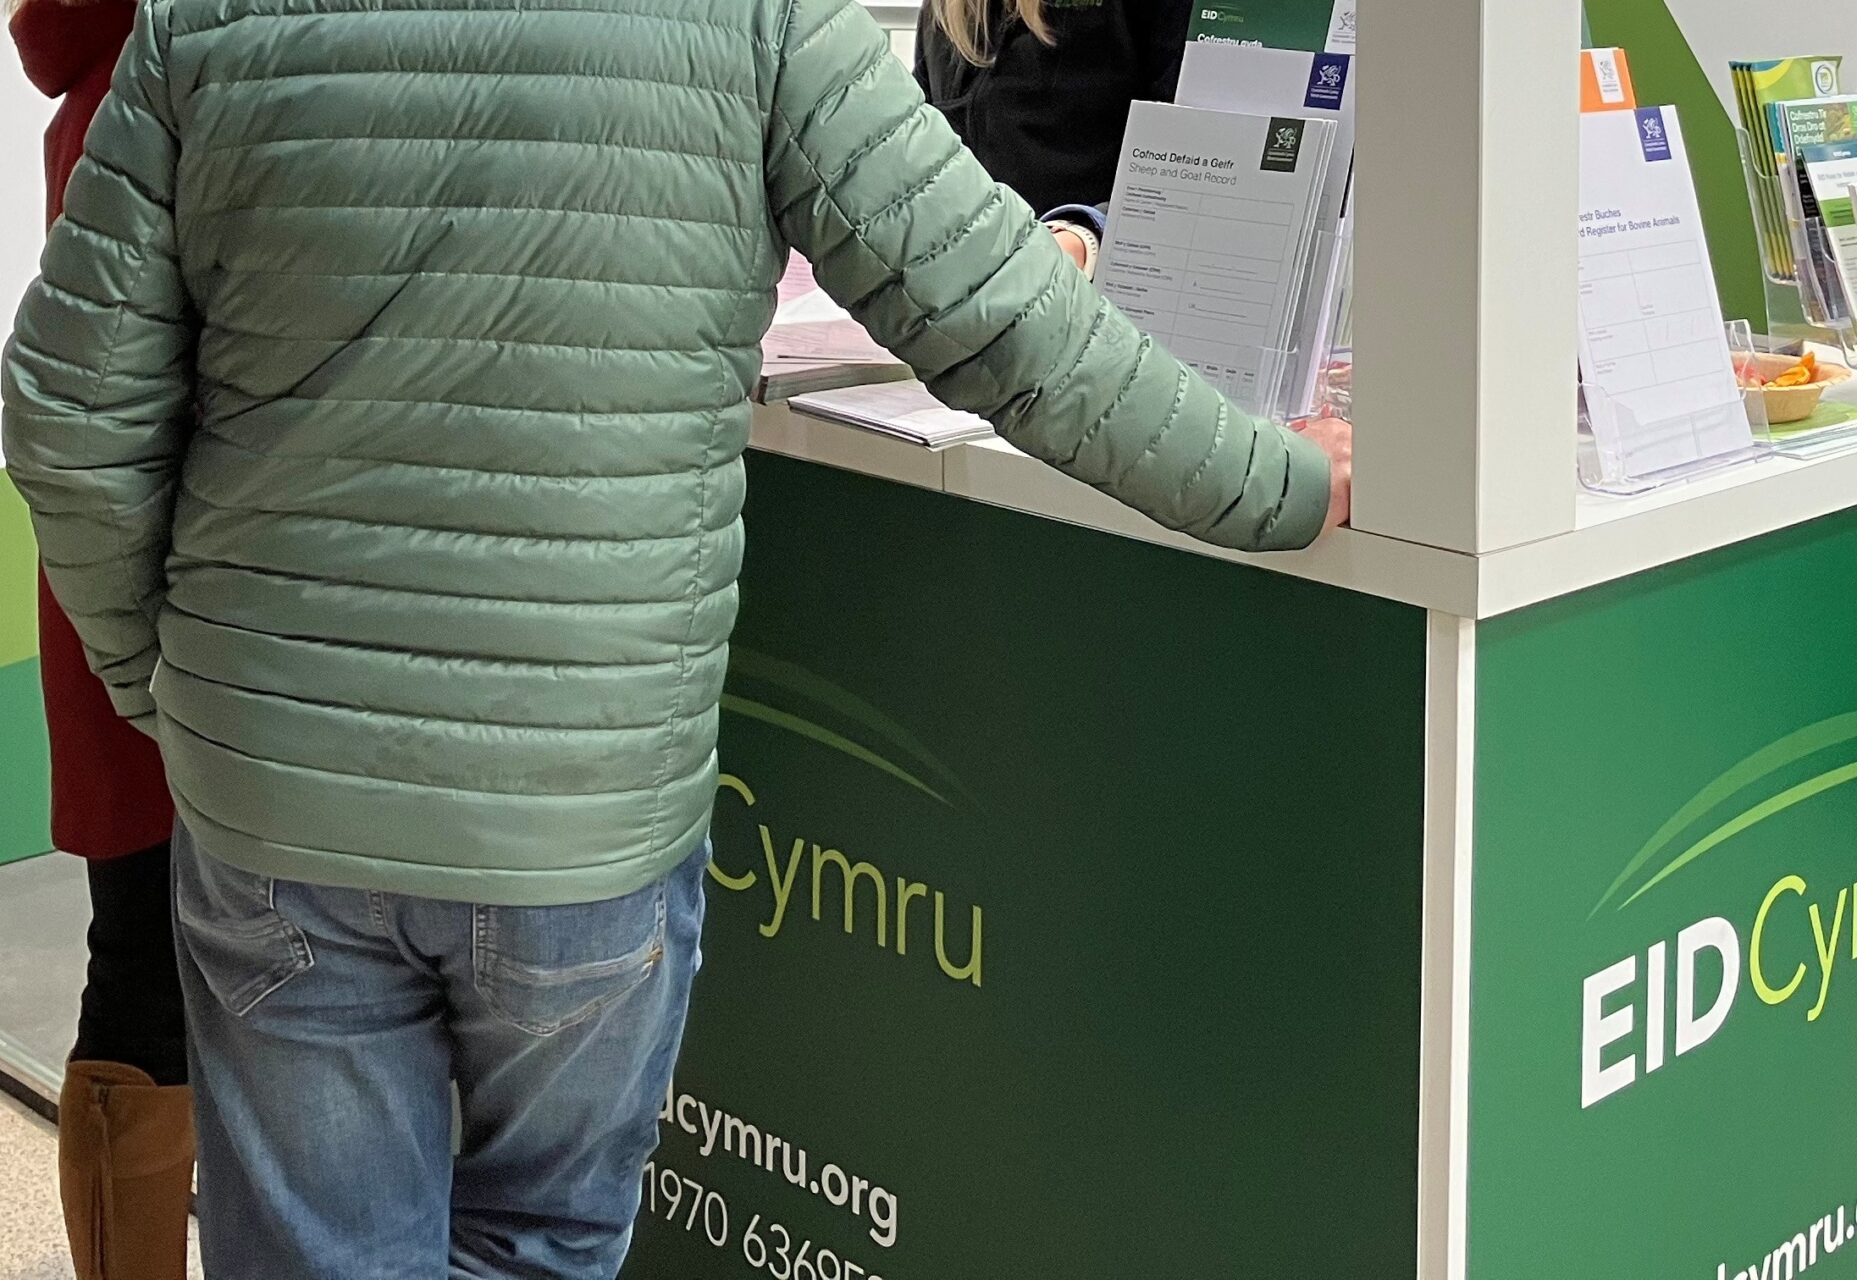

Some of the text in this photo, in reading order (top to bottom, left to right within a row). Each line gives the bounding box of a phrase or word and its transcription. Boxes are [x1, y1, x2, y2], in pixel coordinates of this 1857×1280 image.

[1132, 148, 1235, 169] Cofnod Defaid a Geifr
[1128, 161, 1237, 186] Sheep and Goat Record
[1587, 225, 1617, 237] Register
[1617, 222, 1627, 232] for
[1627, 220, 1652, 231] Bovine
[1652, 215, 1681, 227] Animals
[1594, 209, 1622, 220] Buches
[1580, 874, 1857, 1109] EIDCy
[743, 1214, 884, 1280] 6369
